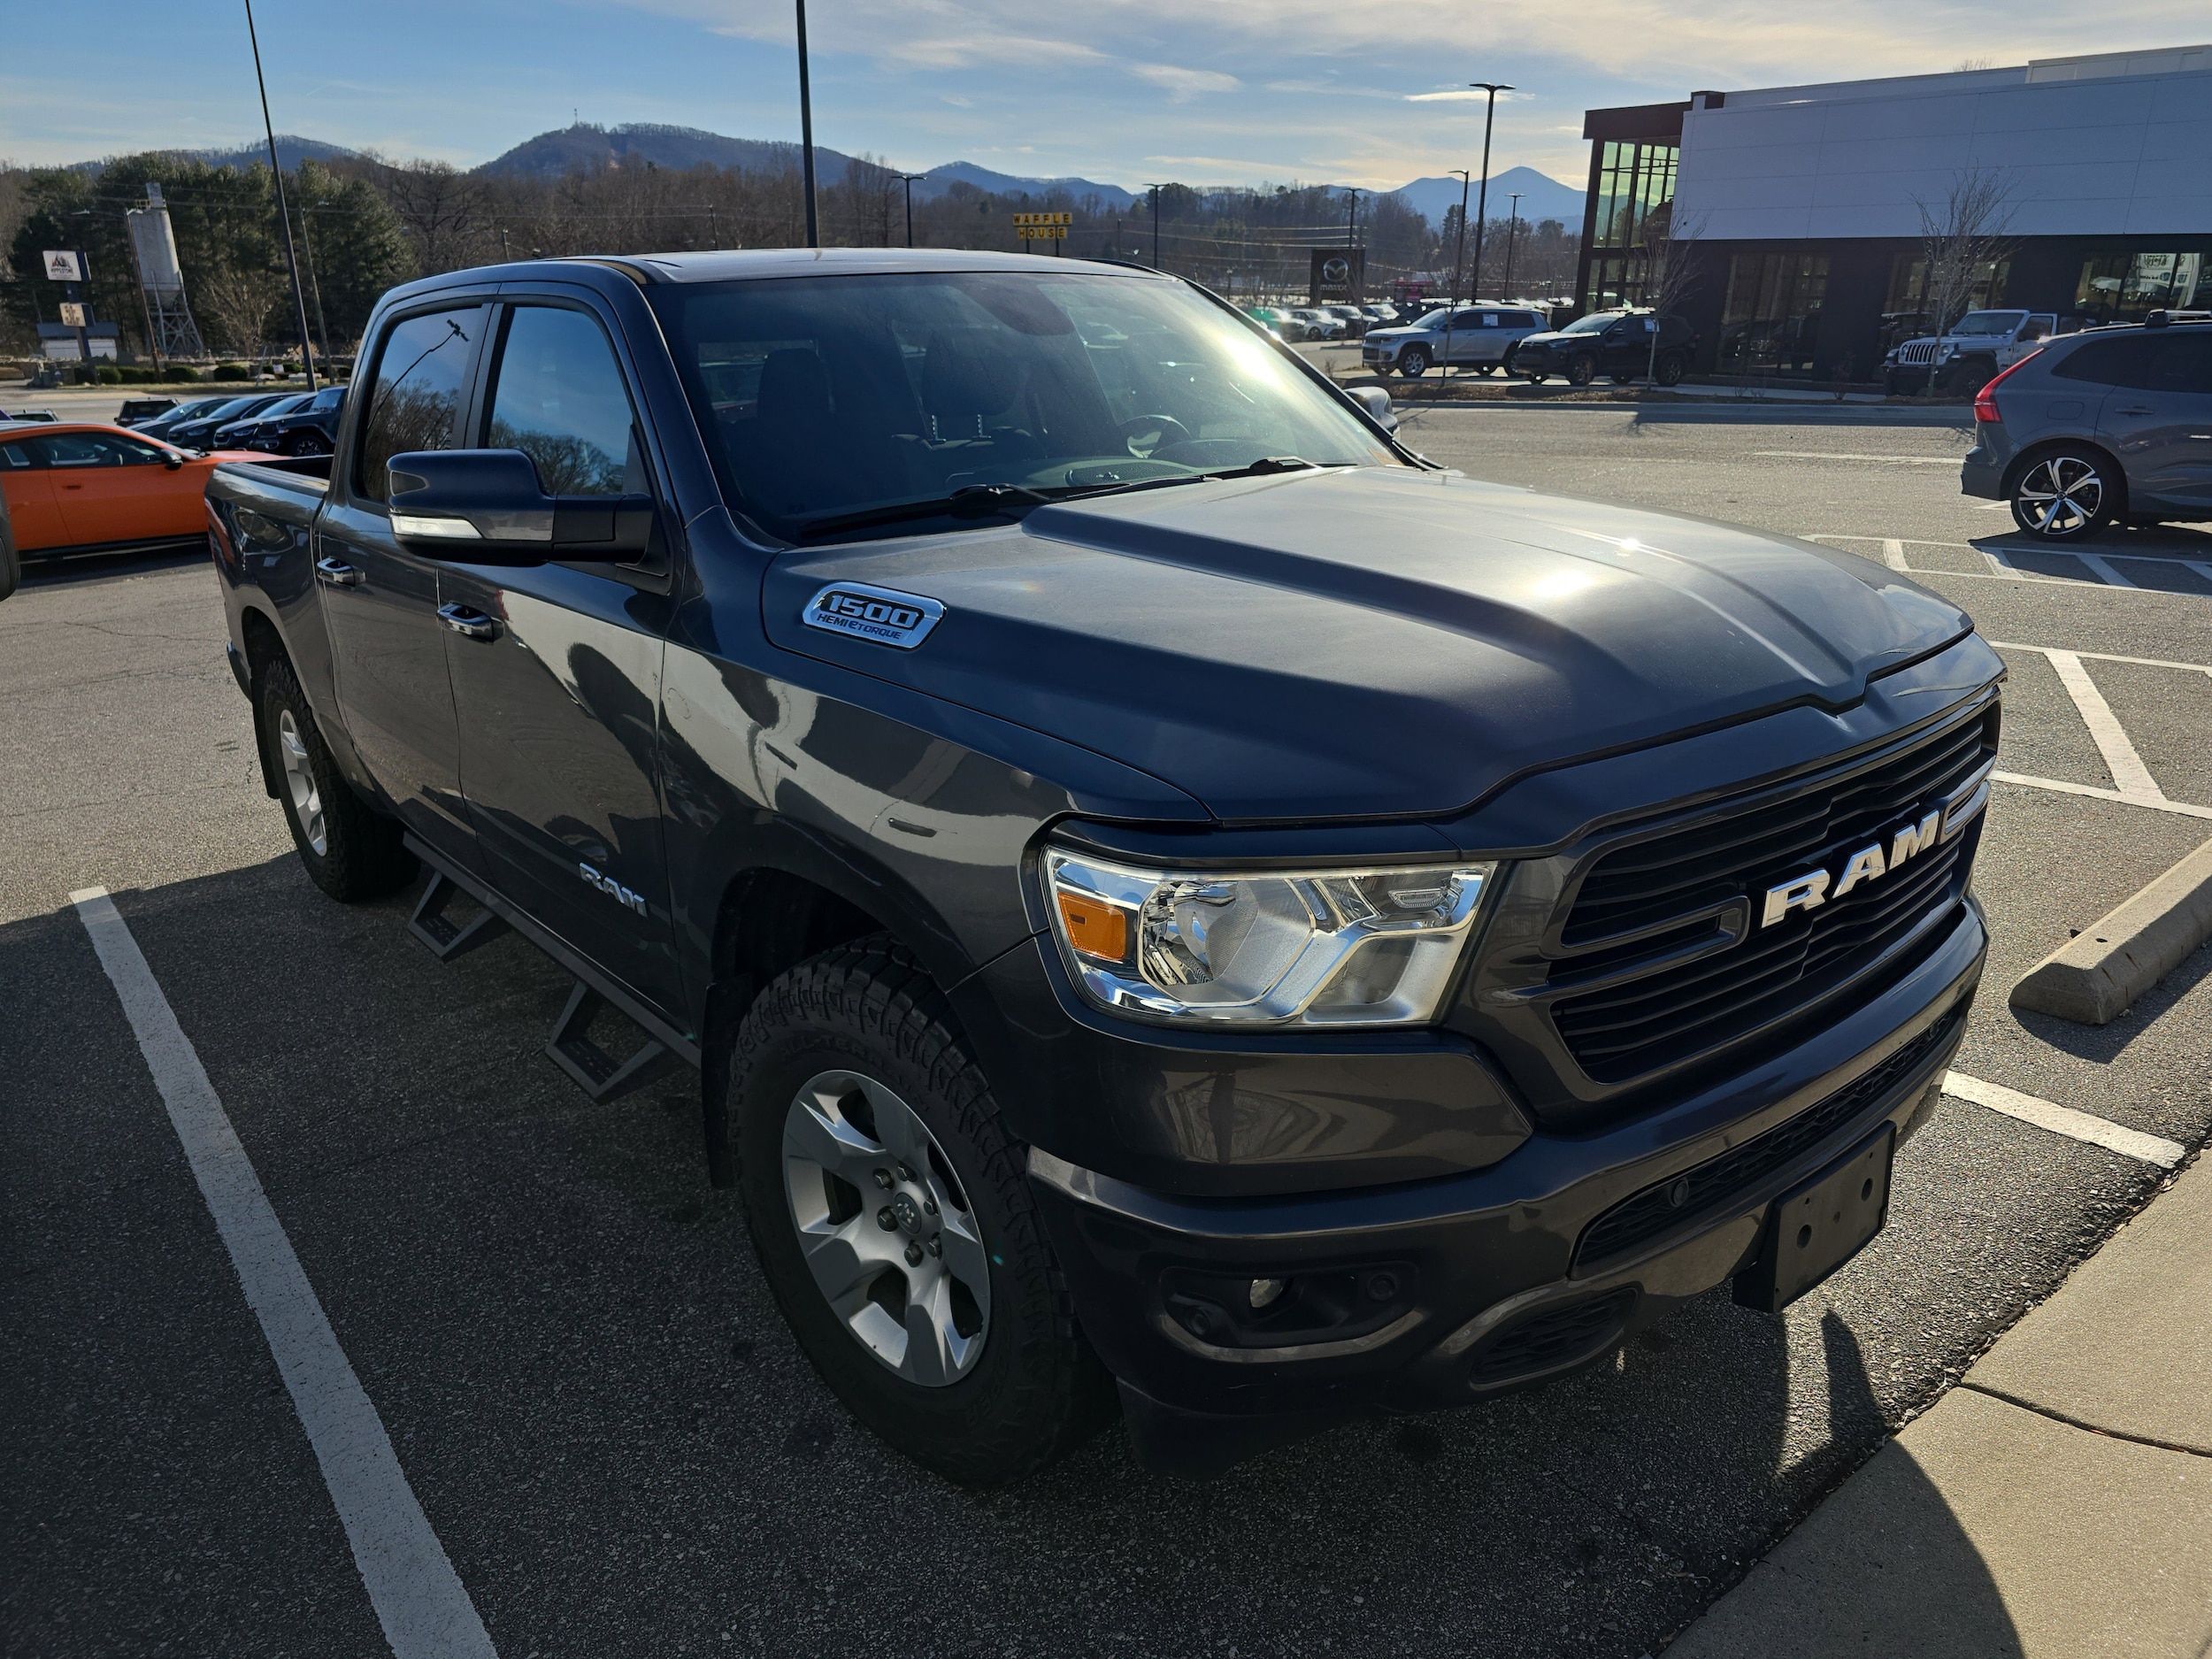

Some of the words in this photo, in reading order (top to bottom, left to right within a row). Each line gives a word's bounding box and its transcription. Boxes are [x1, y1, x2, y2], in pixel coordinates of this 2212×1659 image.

[1013, 213, 1070, 224] WAFFLE
[1019, 227, 1065, 238] HOUSE
[830, 595, 919, 628] 1500
[1761, 809, 1940, 929] RAM
[579, 862, 649, 918] RAM
